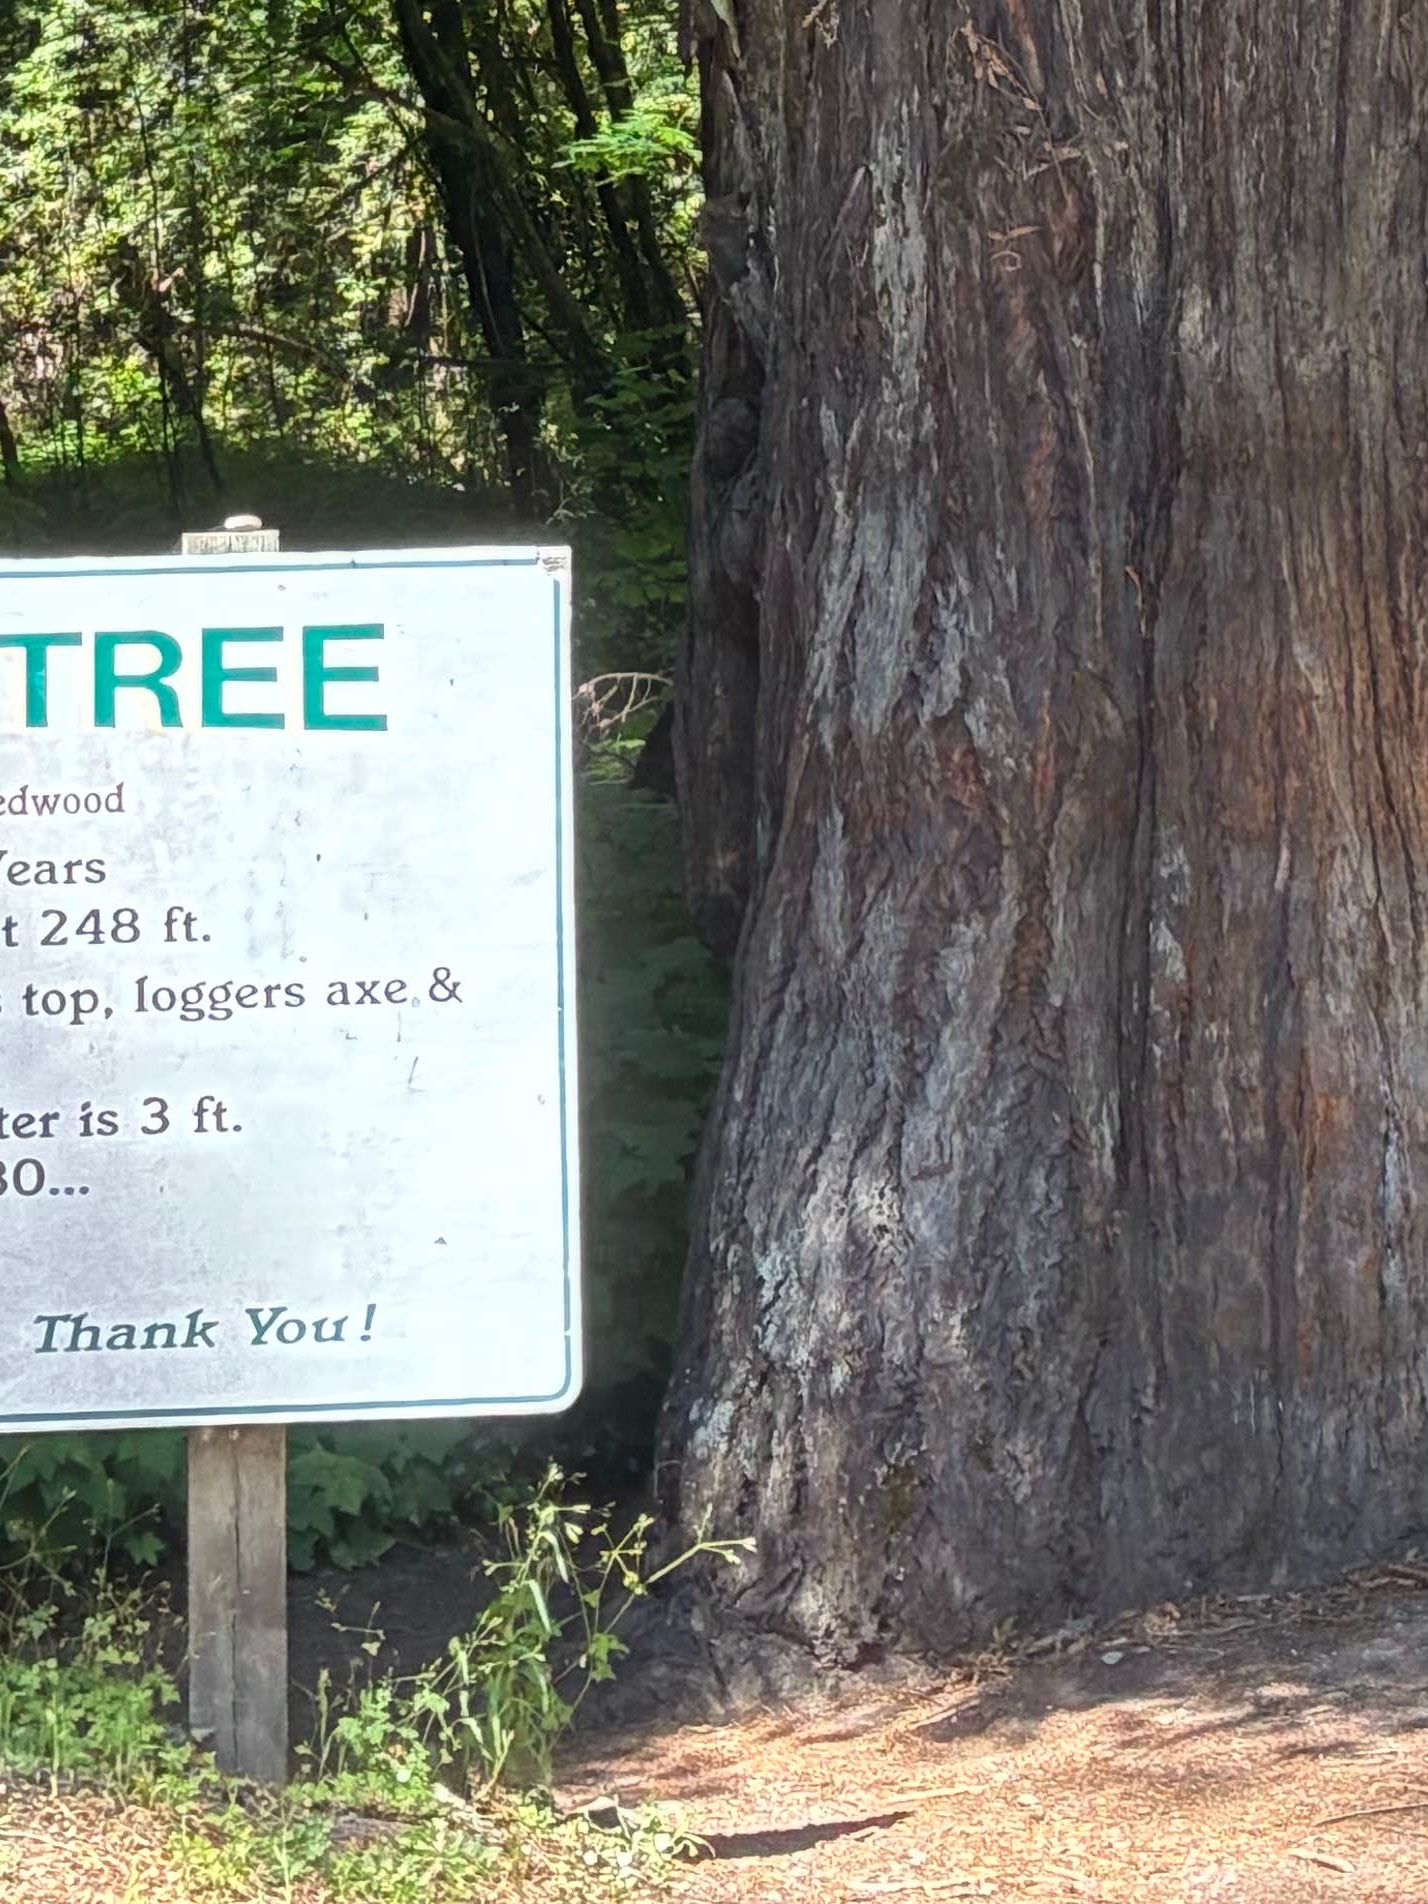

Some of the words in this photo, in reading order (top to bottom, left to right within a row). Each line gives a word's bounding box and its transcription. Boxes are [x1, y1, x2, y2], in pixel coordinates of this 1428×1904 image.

[40, 907, 141, 947] 248
[163, 905, 211, 943] ft.
[21, 983, 114, 1026] top,
[134, 975, 306, 1023] loggers
[326, 979, 408, 1006] axe
[428, 966, 463, 1004] &
[78, 1100, 119, 1138] is
[140, 1096, 170, 1135] 3
[193, 1095, 243, 1134] ft.
[33, 1308, 220, 1354] Thank
[244, 1303, 377, 1346] You!
